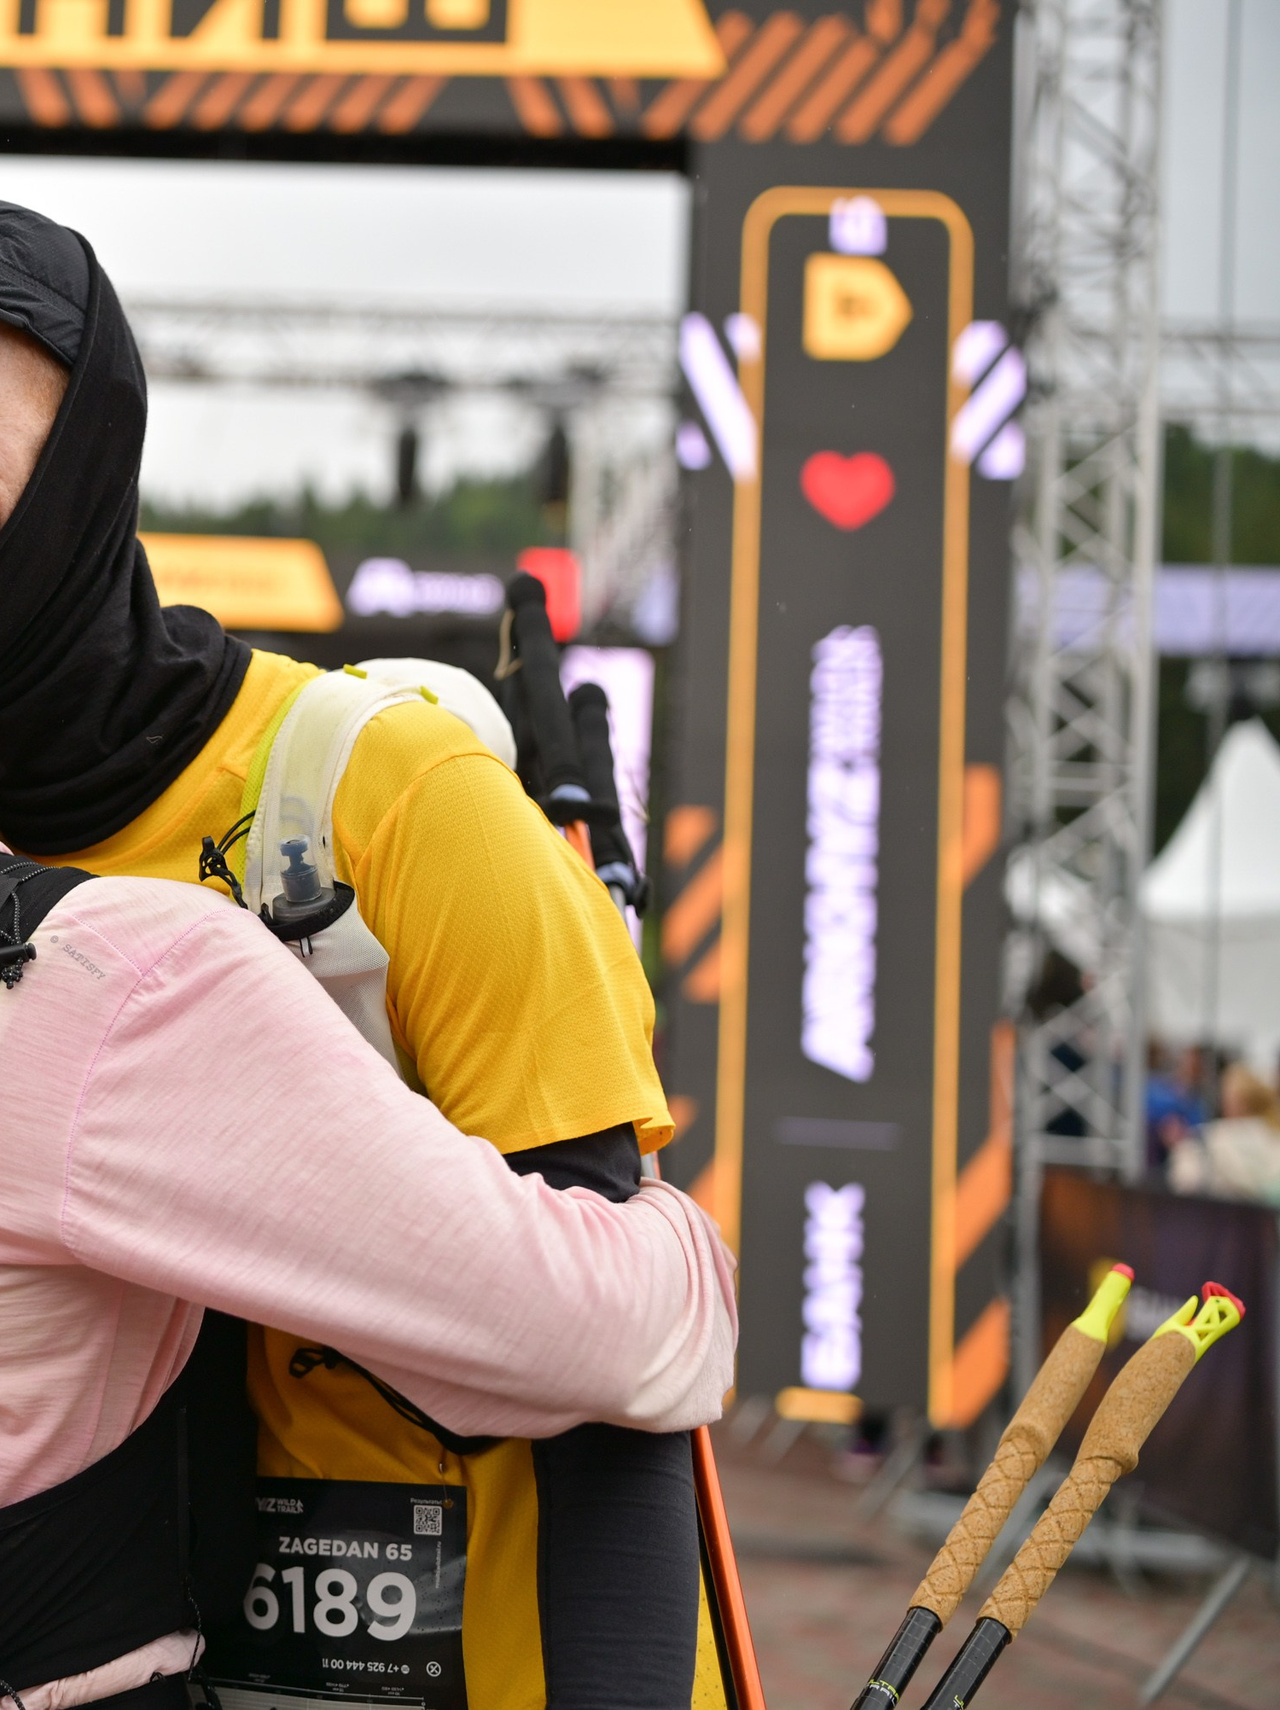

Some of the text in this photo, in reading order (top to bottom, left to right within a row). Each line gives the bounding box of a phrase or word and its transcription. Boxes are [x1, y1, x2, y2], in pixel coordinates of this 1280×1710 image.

[63, 944, 106, 980] SATISFY
[278, 1536, 413, 1561] ZAGEDAN 65
[243, 1563, 417, 1641] 6189
[330, 1658, 345, 1670] 00
[346, 1659, 366, 1670] 444
[367, 1661, 386, 1672] 925
[387, 1663, 400, 1673] +7
